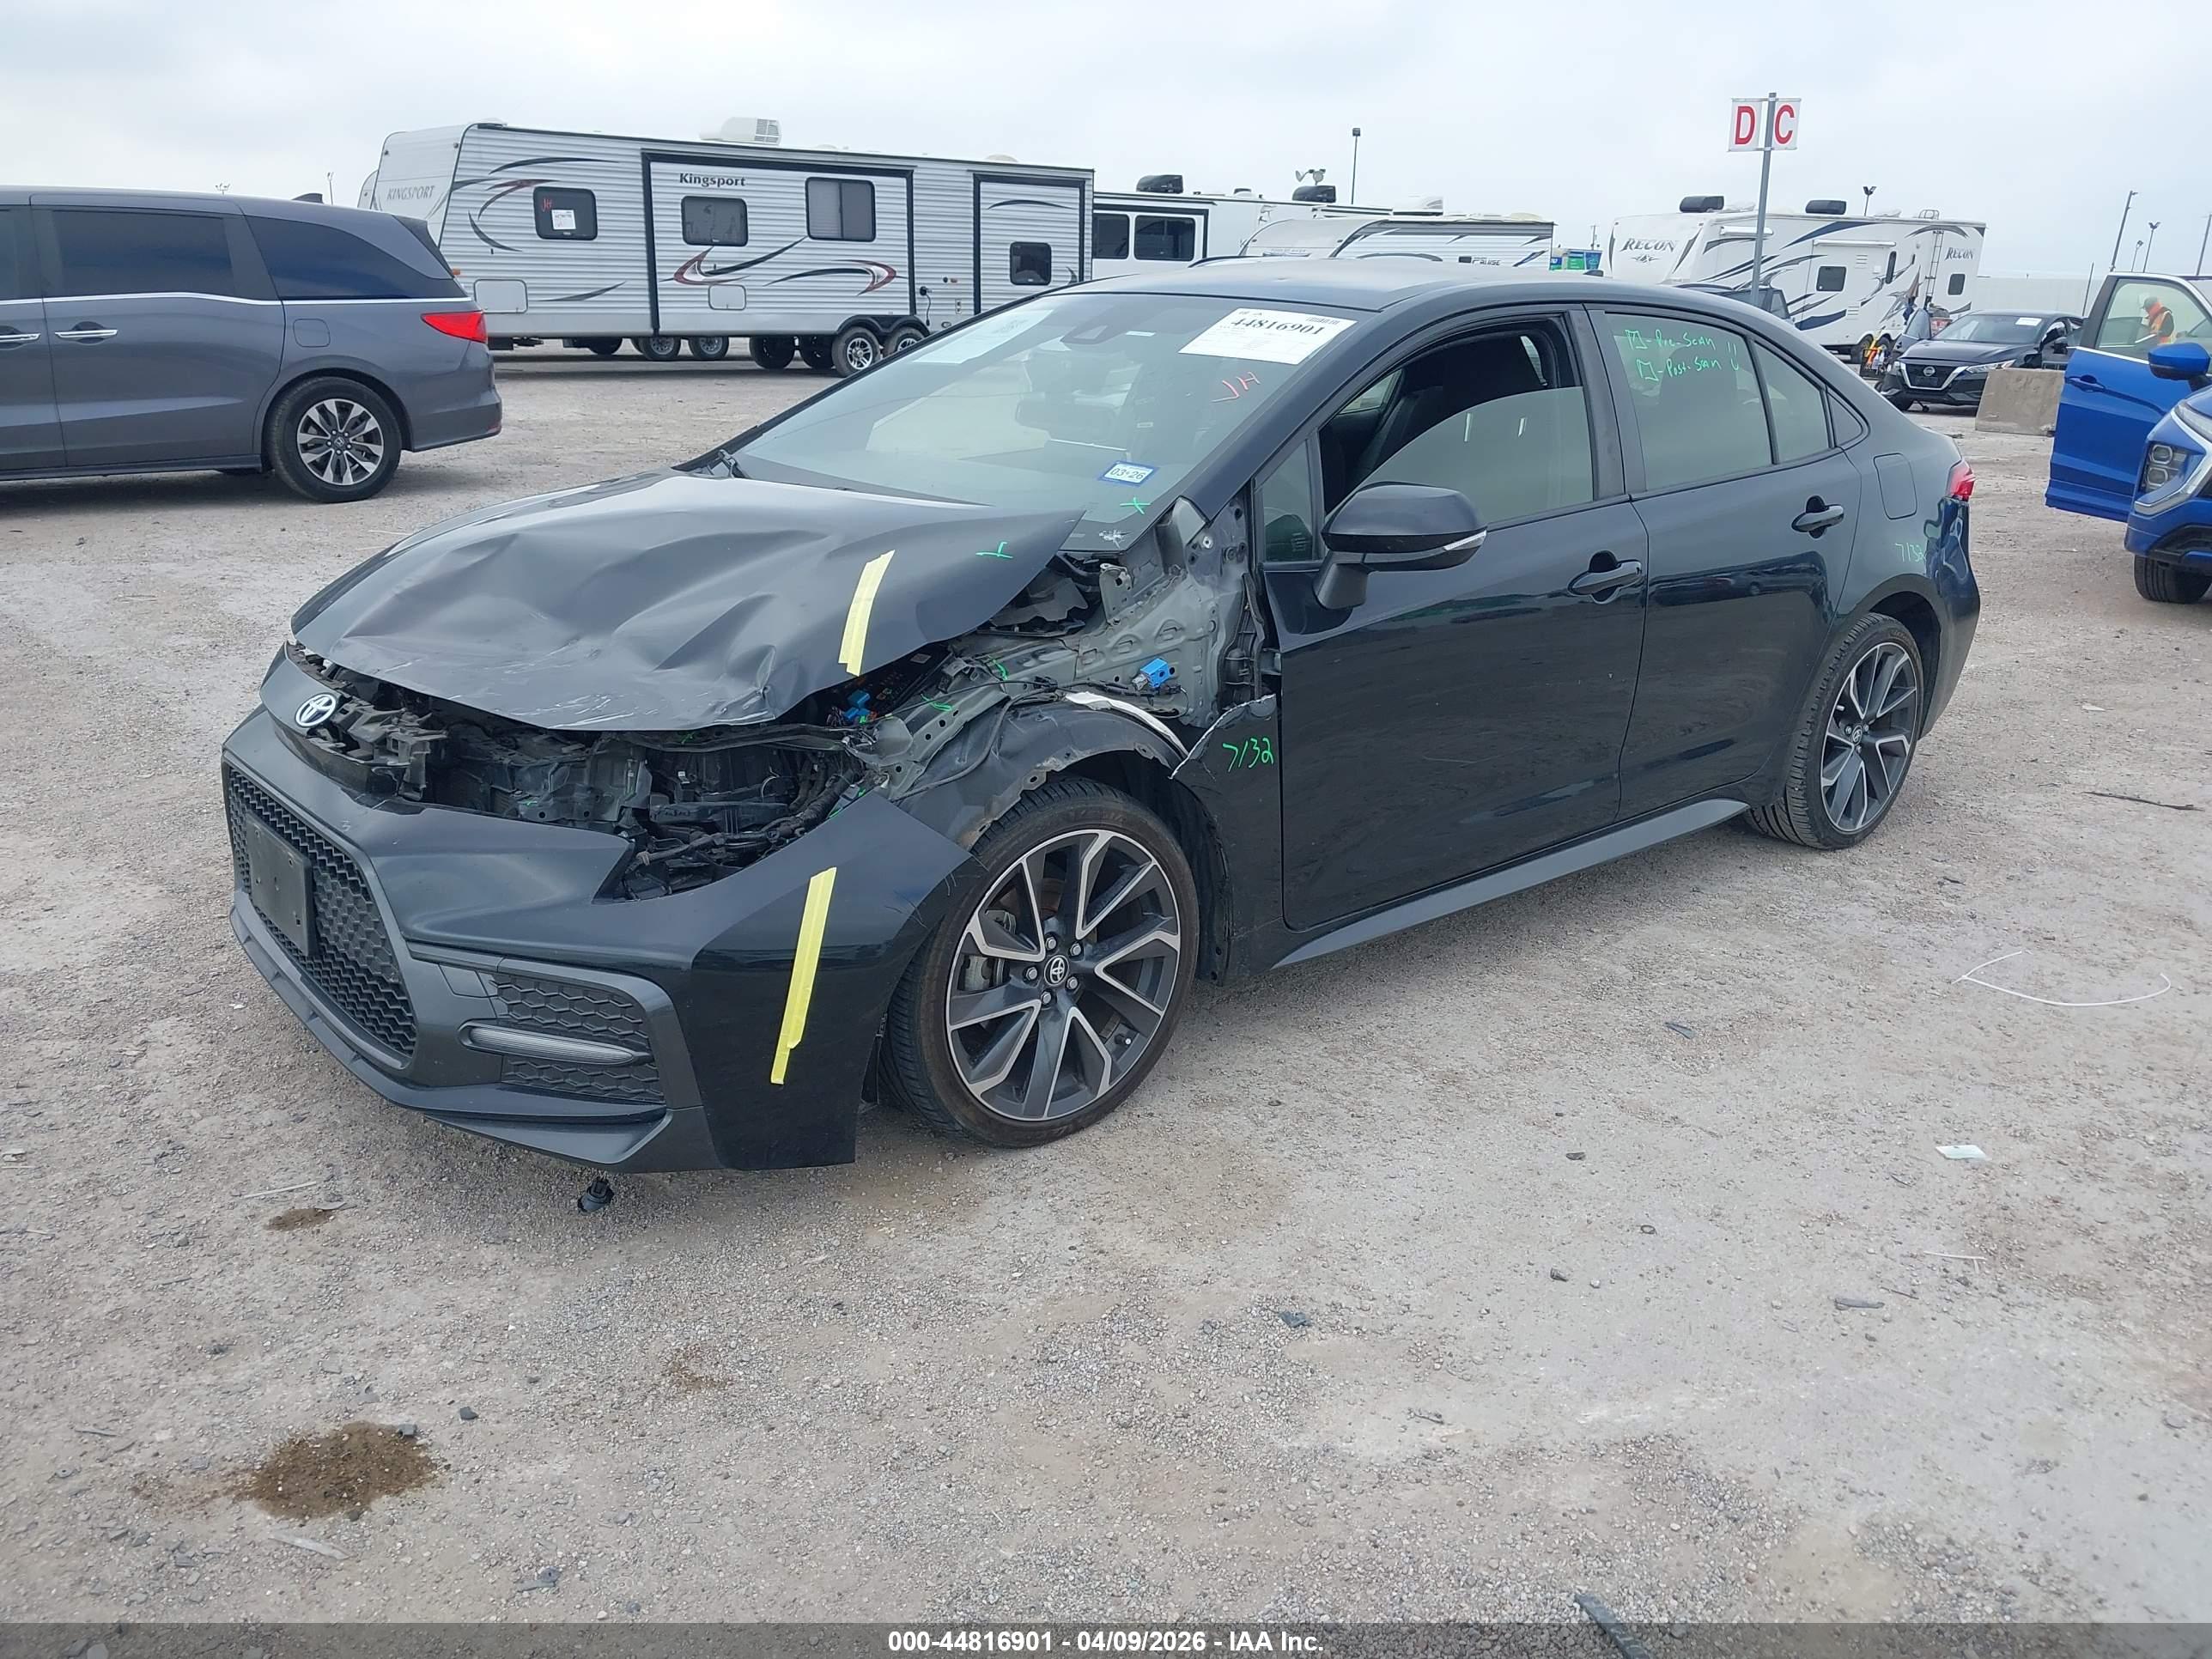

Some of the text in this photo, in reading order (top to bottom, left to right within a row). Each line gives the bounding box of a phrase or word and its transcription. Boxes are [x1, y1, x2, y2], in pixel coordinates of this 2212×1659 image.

[1735, 106, 1755, 144] D
[1774, 104, 1794, 144] C
[678, 173, 746, 187] Kingsport
[386, 185, 434, 200] KINGSPORT
[1620, 238, 1674, 252] RECON
[1944, 246, 1973, 260] RECON
[1231, 317, 1326, 335] 44816901
[1222, 737, 1274, 772] 7132
